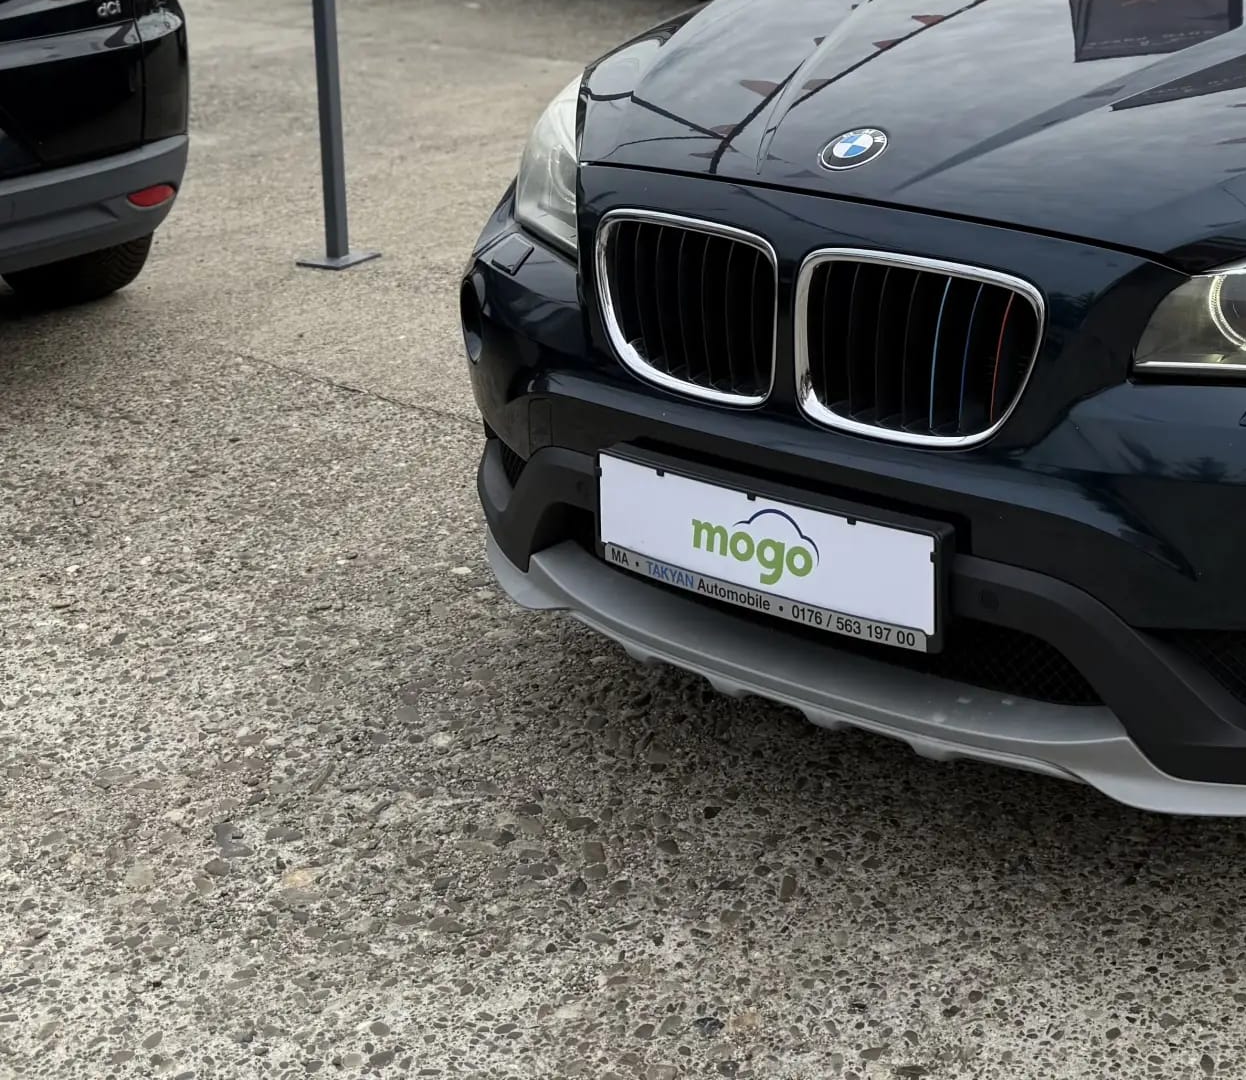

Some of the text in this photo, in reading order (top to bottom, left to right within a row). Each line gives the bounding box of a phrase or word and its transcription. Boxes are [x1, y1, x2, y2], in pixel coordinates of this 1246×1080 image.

[97, 0, 121, 16] dCi
[691, 518, 814, 585] mogo
[611, 547, 630, 567] MA
[646, 560, 694, 589] TAKYAN
[697, 578, 771, 611] Automobile
[791, 604, 823, 625] 0176
[836, 616, 861, 635] 563
[866, 624, 892, 642] 197
[896, 630, 916, 647] 00
